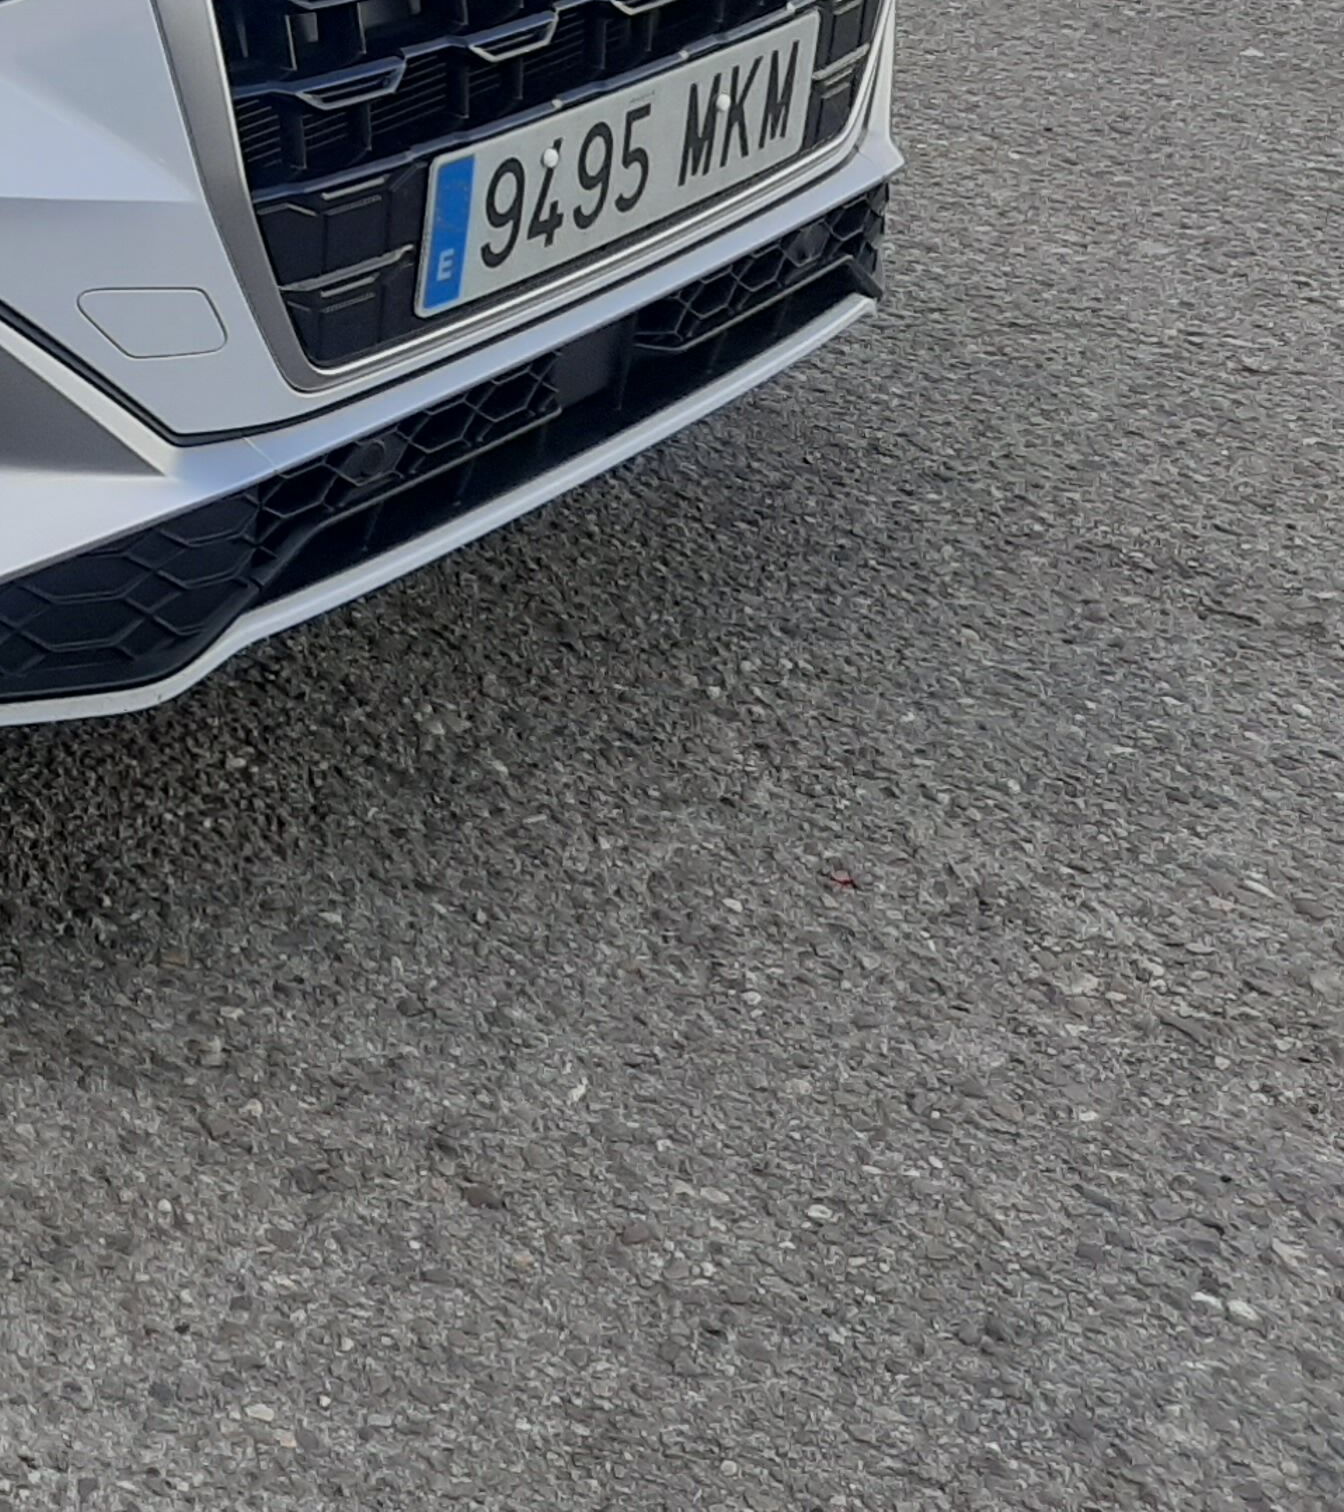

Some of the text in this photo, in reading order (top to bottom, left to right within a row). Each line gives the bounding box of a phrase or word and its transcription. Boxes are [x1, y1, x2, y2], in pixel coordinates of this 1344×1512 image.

[480, 40, 800, 268] 9495 MKM
[435, 248, 455, 281] E
